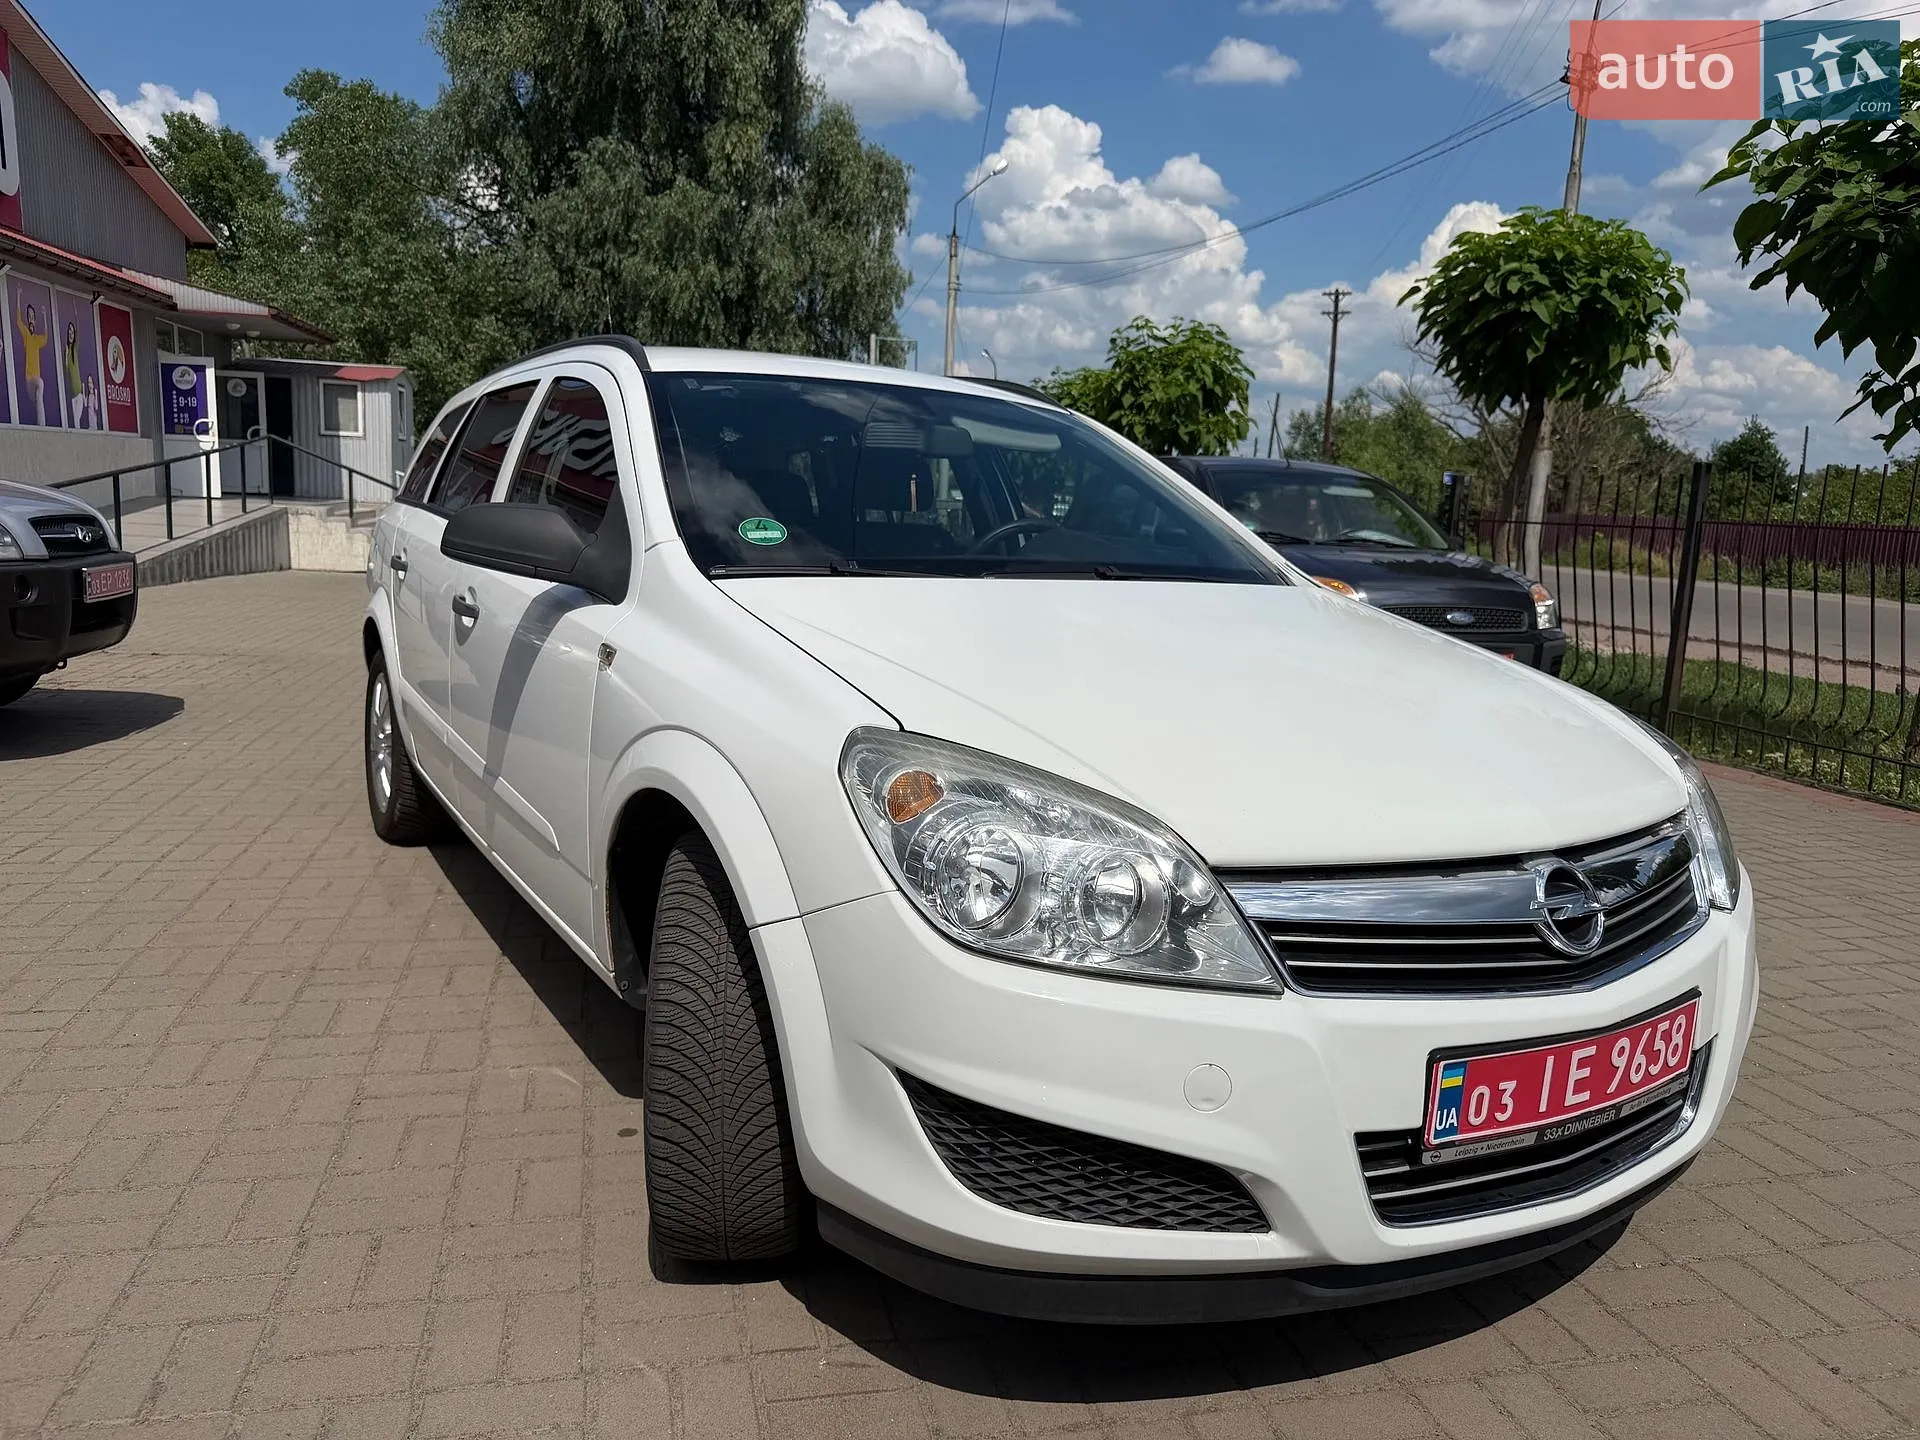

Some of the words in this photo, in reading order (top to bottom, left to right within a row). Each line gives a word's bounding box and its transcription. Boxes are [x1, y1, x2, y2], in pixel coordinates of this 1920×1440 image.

[755, 519, 768, 531] 4
[1467, 1080, 1518, 1126] 03
[1538, 1045, 1597, 1114] IE
[1606, 1014, 1687, 1094] 9658
[1435, 1106, 1458, 1131] UA
[1454, 1146, 1479, 1158] Leipzig
[1485, 1136, 1525, 1152] Niederrhein
